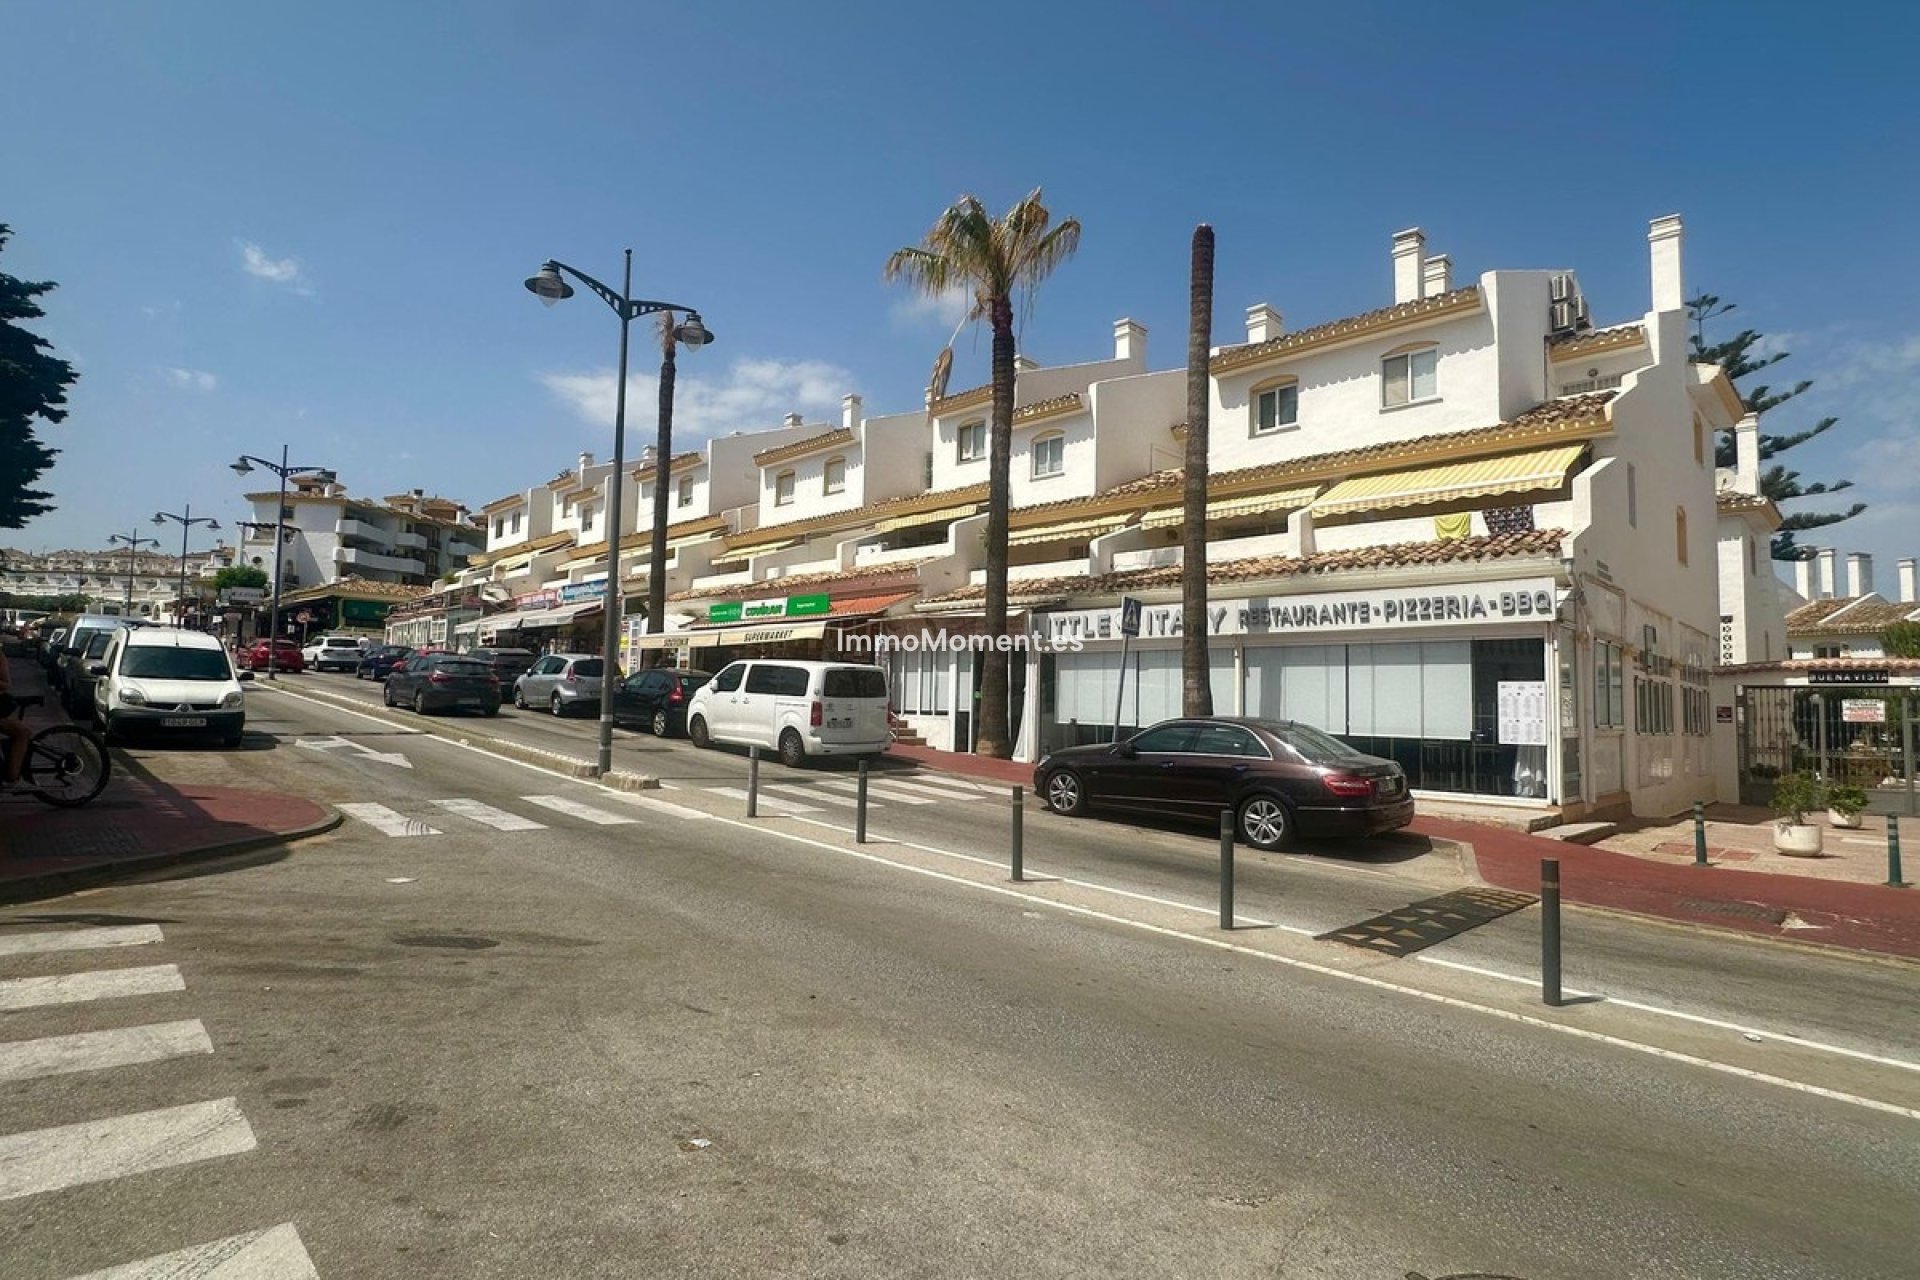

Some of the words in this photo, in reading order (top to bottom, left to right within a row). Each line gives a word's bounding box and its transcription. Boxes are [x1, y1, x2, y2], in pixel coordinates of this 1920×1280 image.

[1146, 606, 1227, 636] ITAY
[1238, 601, 1371, 629] RESTAURANTE
[1383, 594, 1488, 622] PIZZERIA
[1500, 590, 1553, 616] BBQ
[744, 630, 794, 643] SUPERMARKET
